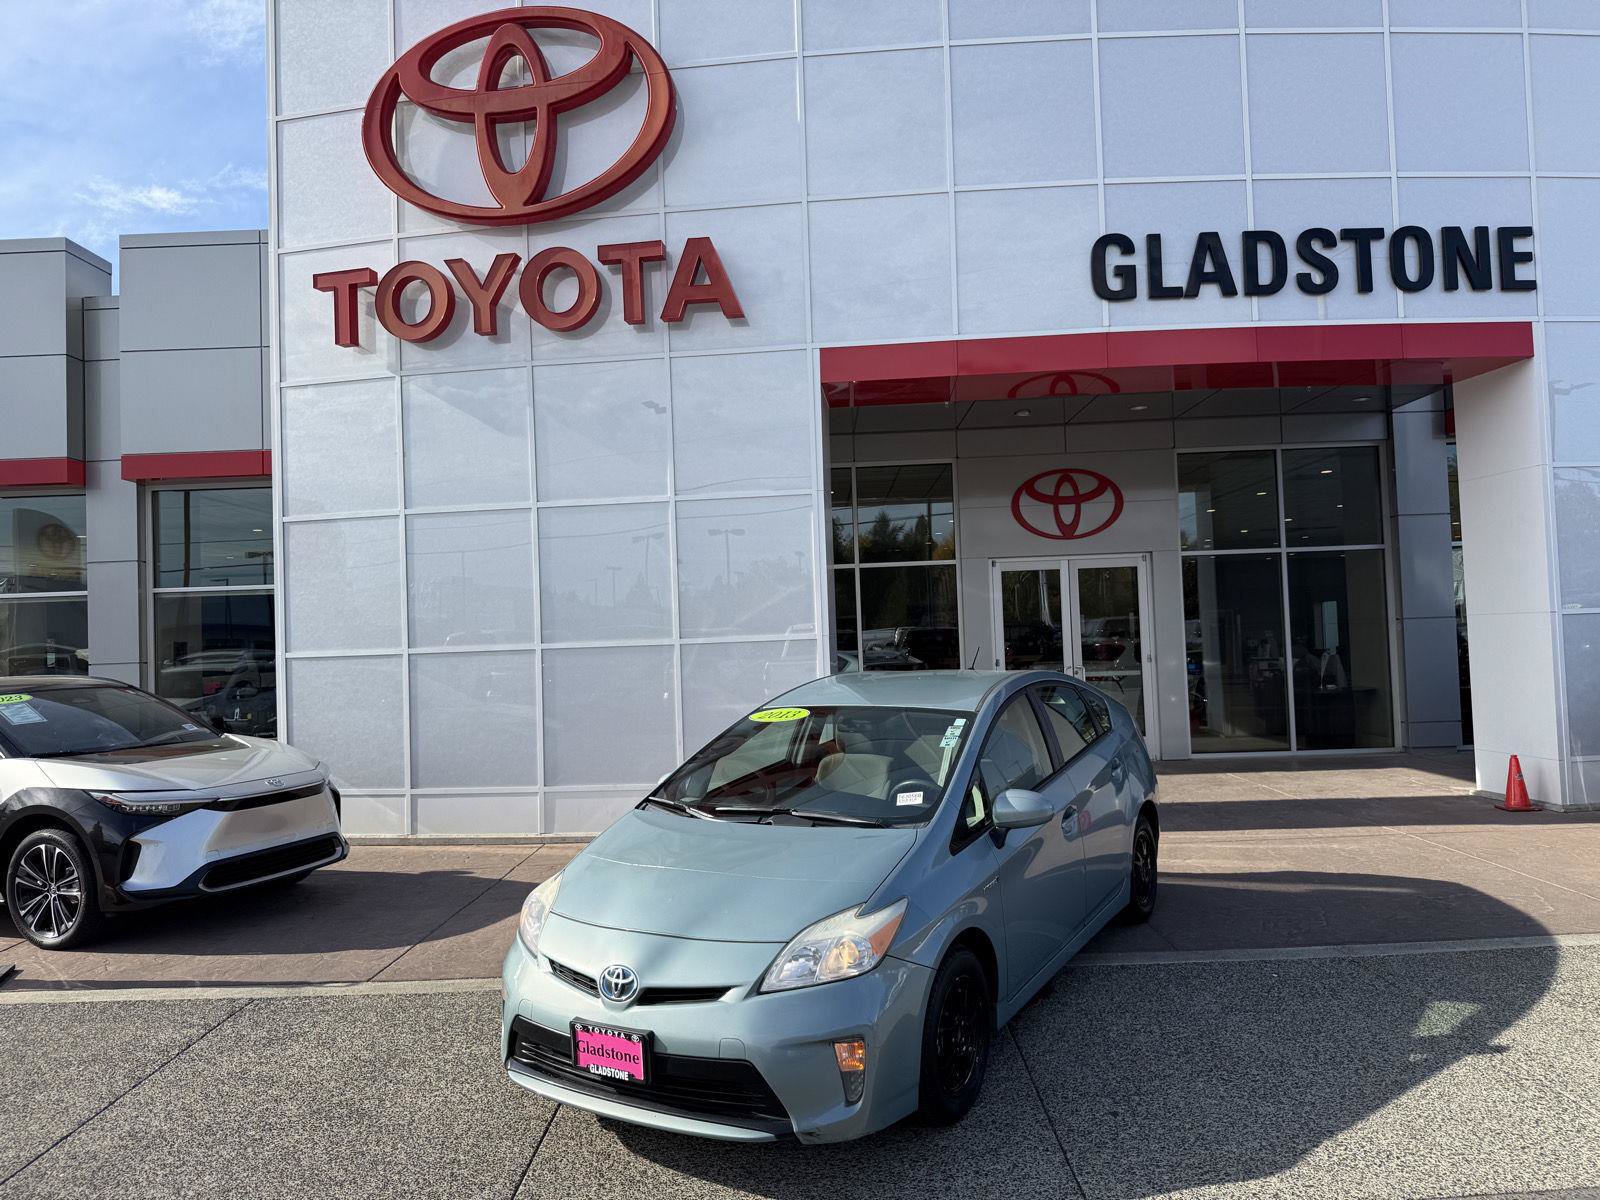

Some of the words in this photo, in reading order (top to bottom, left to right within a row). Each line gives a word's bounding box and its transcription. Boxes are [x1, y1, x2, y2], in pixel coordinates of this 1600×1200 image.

[1091, 226, 1537, 301] GLADSTONE
[313, 236, 746, 348] TOYOTA
[758, 710, 802, 719] 2013
[588, 1026, 626, 1039] TOYOTA
[577, 1040, 640, 1065] Gladstone
[589, 1064, 629, 1081] GLADSTONE
